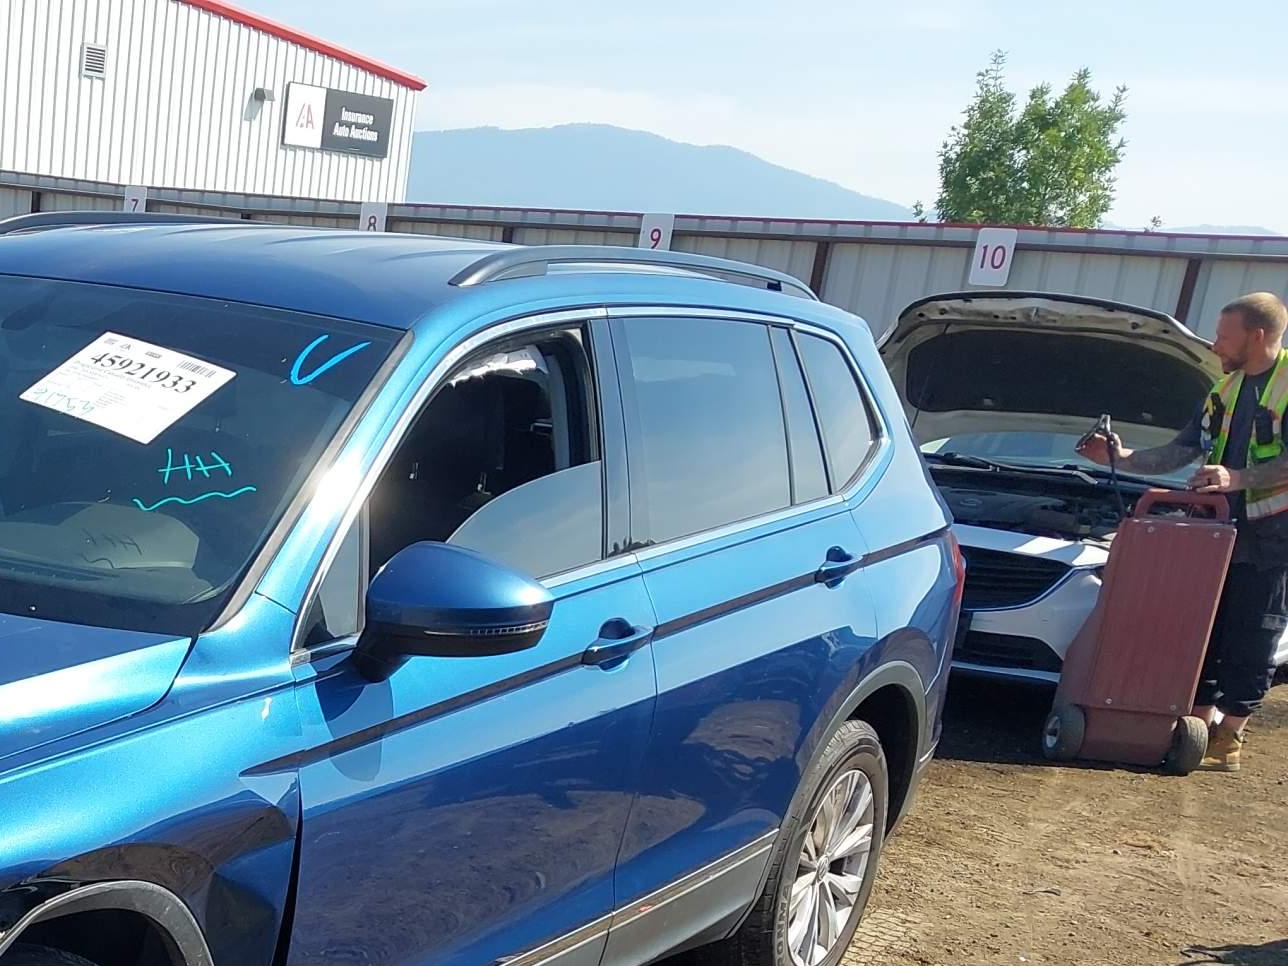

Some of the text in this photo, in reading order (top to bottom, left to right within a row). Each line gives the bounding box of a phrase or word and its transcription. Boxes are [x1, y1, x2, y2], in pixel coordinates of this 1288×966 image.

[341, 107, 374, 124] Insurance
[332, 121, 378, 142] Auto Auctions
[131, 198, 140, 212] 7
[367, 215, 377, 232] 8
[650, 228, 662, 249] 9
[979, 244, 1007, 270] 10
[91, 352, 197, 394] 45921933
